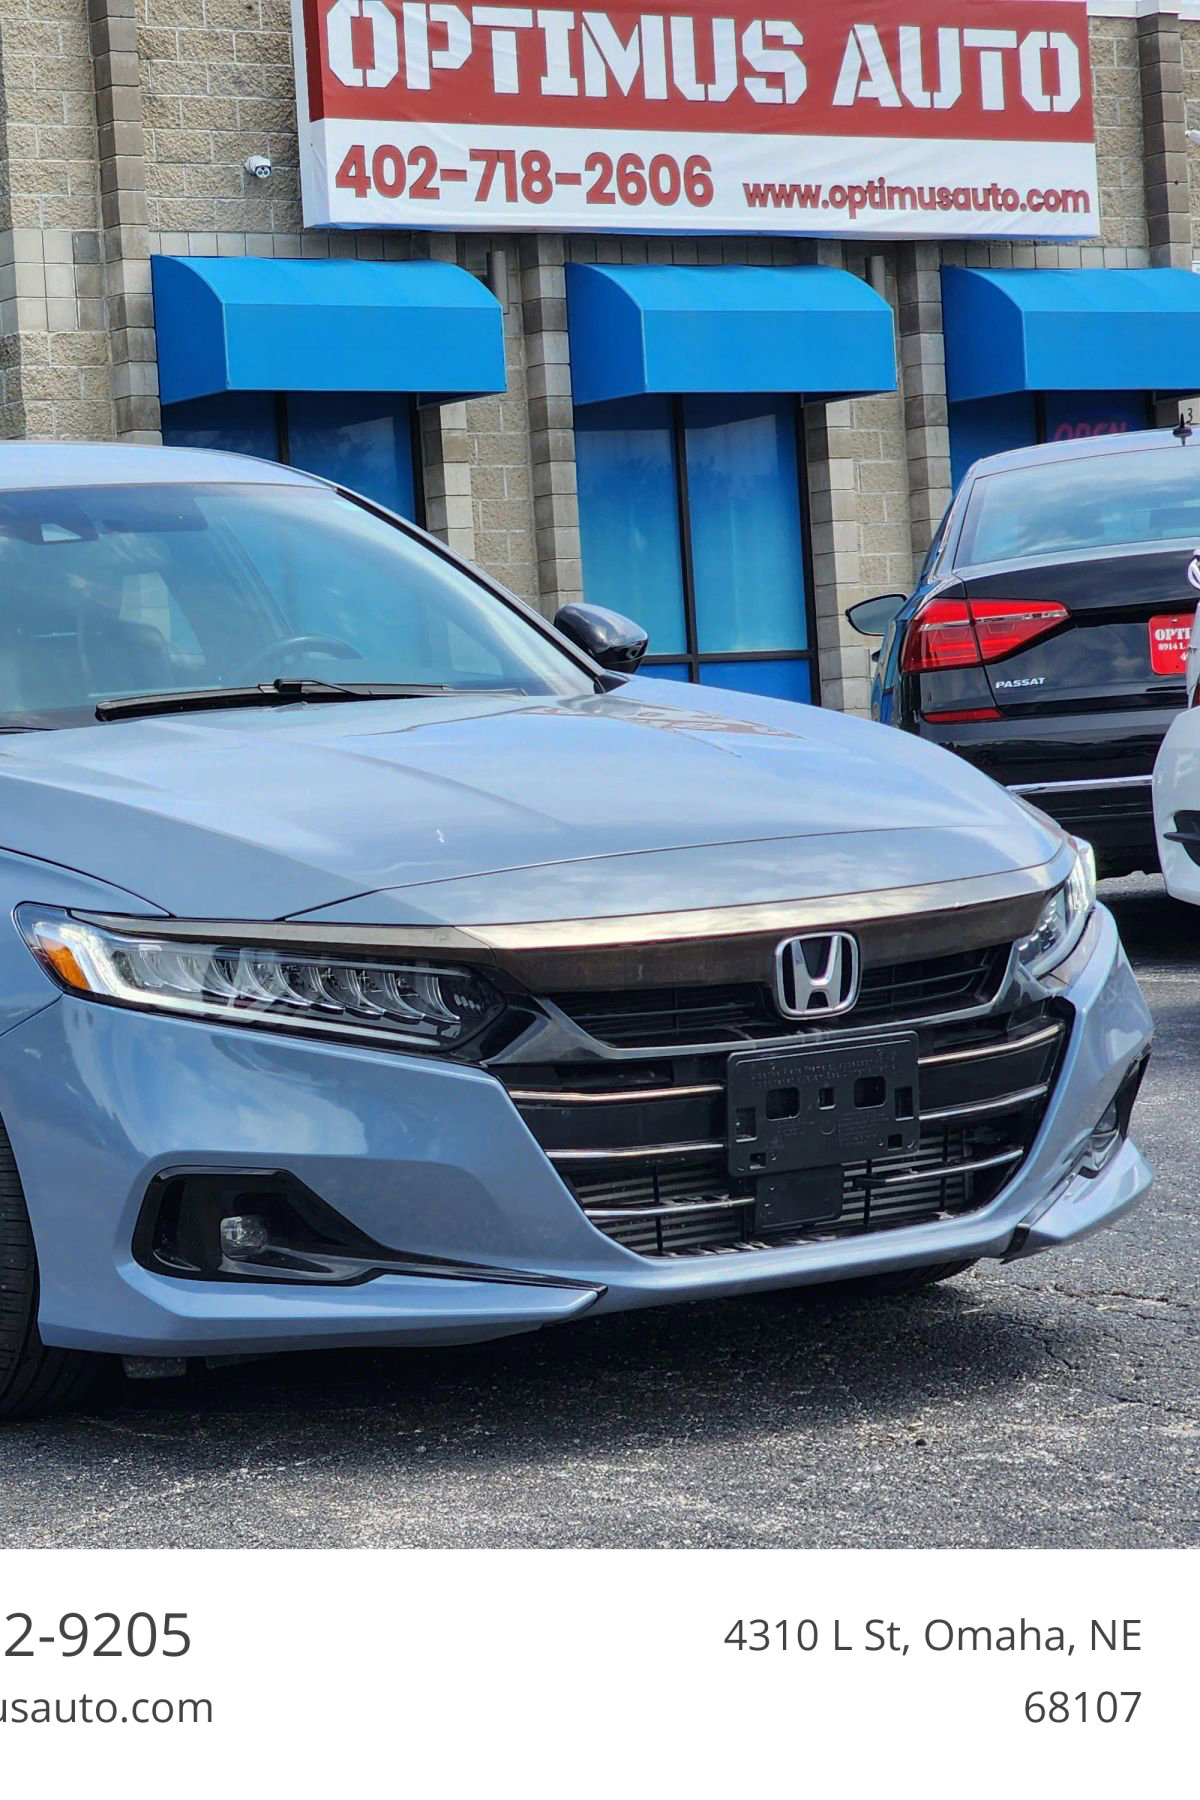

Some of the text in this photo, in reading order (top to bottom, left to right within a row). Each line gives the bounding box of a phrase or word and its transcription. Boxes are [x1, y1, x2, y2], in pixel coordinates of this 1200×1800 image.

[327, 0, 1080, 113] OPTIMUS AUTO
[335, 144, 714, 207] 402-718-2606
[742, 176, 1091, 219] www.optimusauto.com
[1155, 627, 1191, 641] OPTI
[995, 677, 1046, 689] PASSAT
